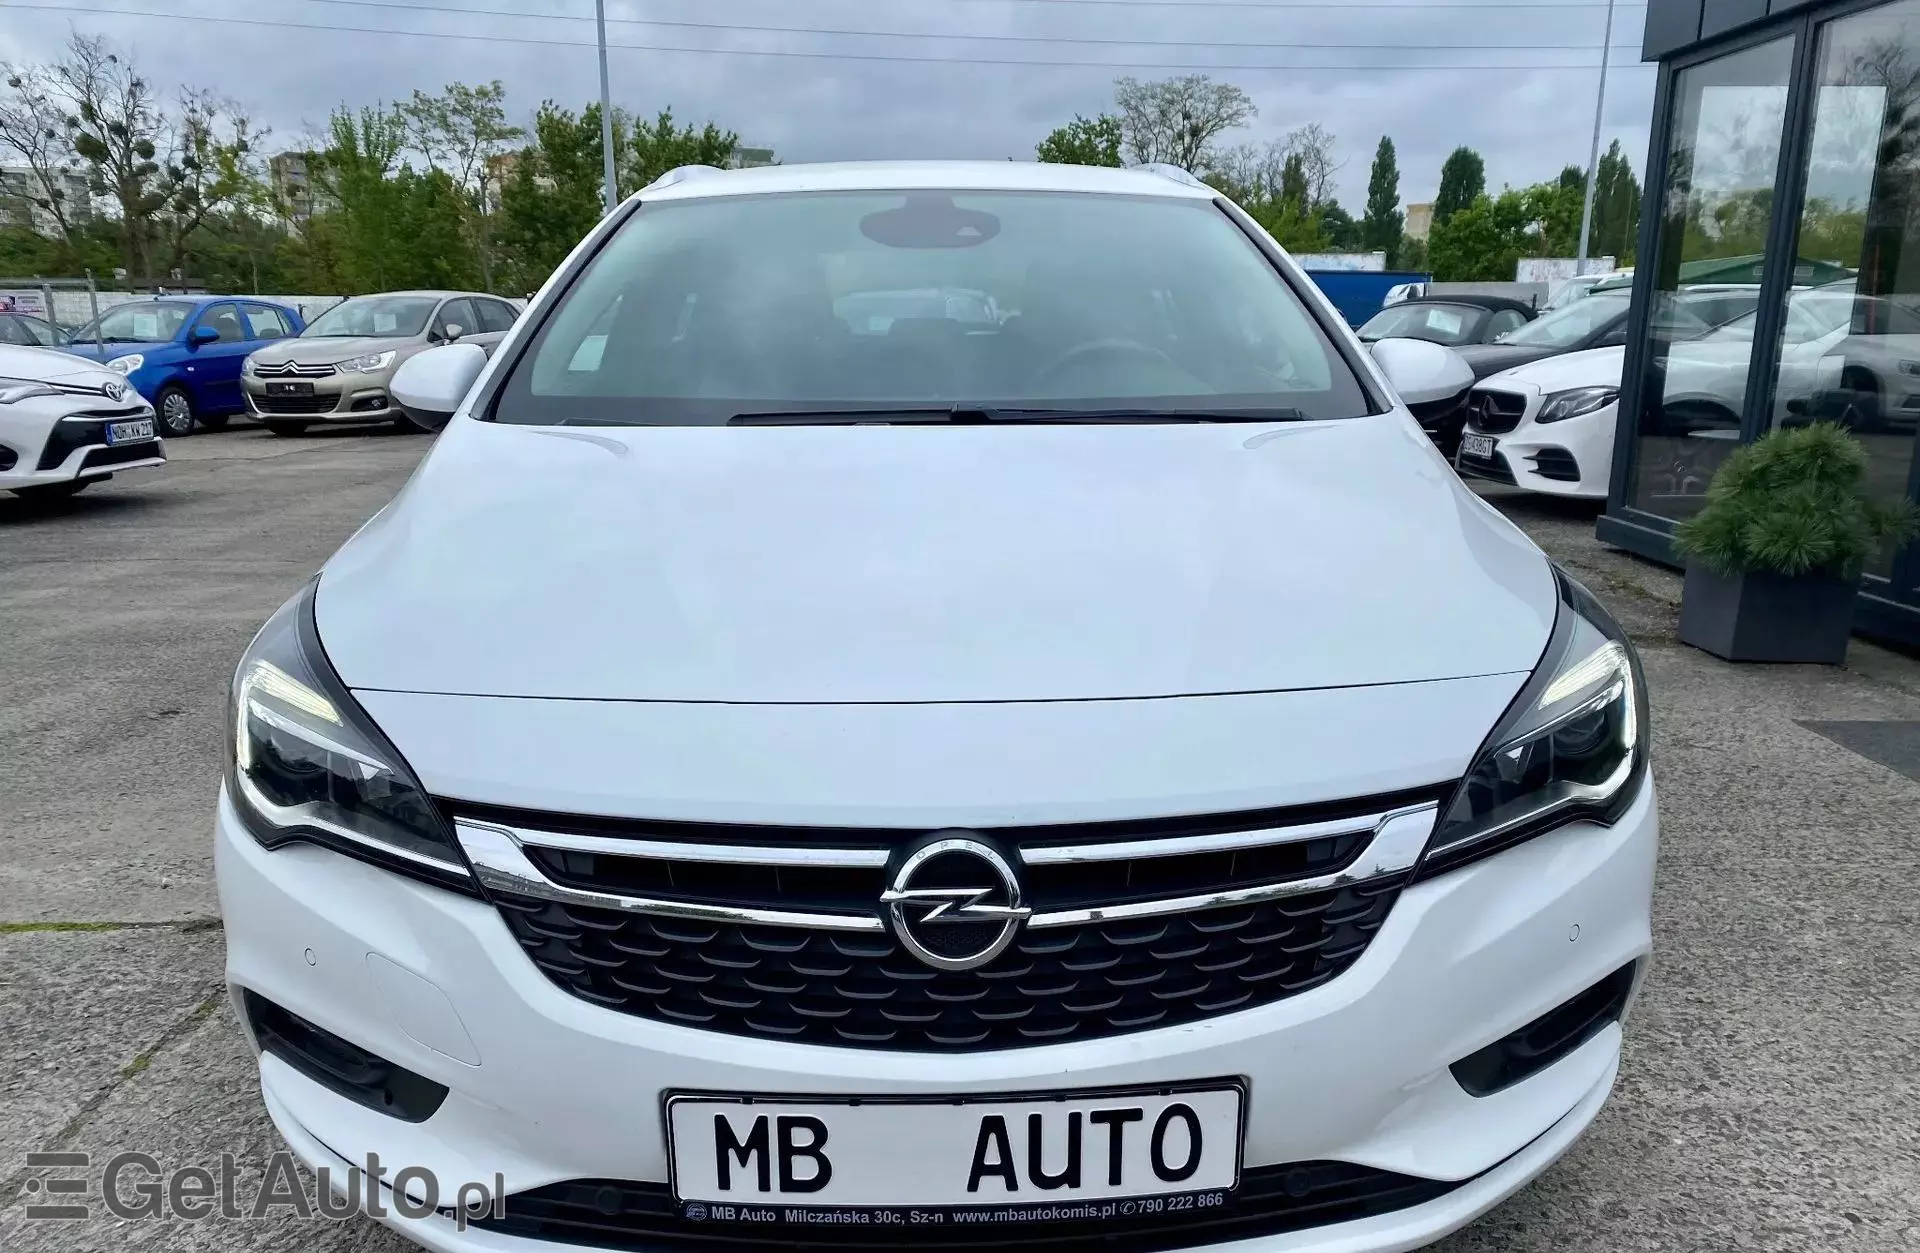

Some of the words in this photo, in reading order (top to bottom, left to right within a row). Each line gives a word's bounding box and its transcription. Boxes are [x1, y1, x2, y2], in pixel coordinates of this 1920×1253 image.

[915, 841, 995, 860] OPEL
[714, 1113, 833, 1194] MB
[966, 1102, 1203, 1193] AUTO
[711, 1206, 736, 1220] MB
[740, 1207, 777, 1222] Auto
[785, 1208, 870, 1224] Milczańska
[874, 1210, 905, 1225] 30c,
[910, 1210, 944, 1224] Sz-n
[952, 1203, 1116, 1222] www.mbautokomis.pl
[1138, 1199, 1164, 1214] 790
[1167, 1196, 1193, 1211] 222
[1197, 1192, 1224, 1208] 866
